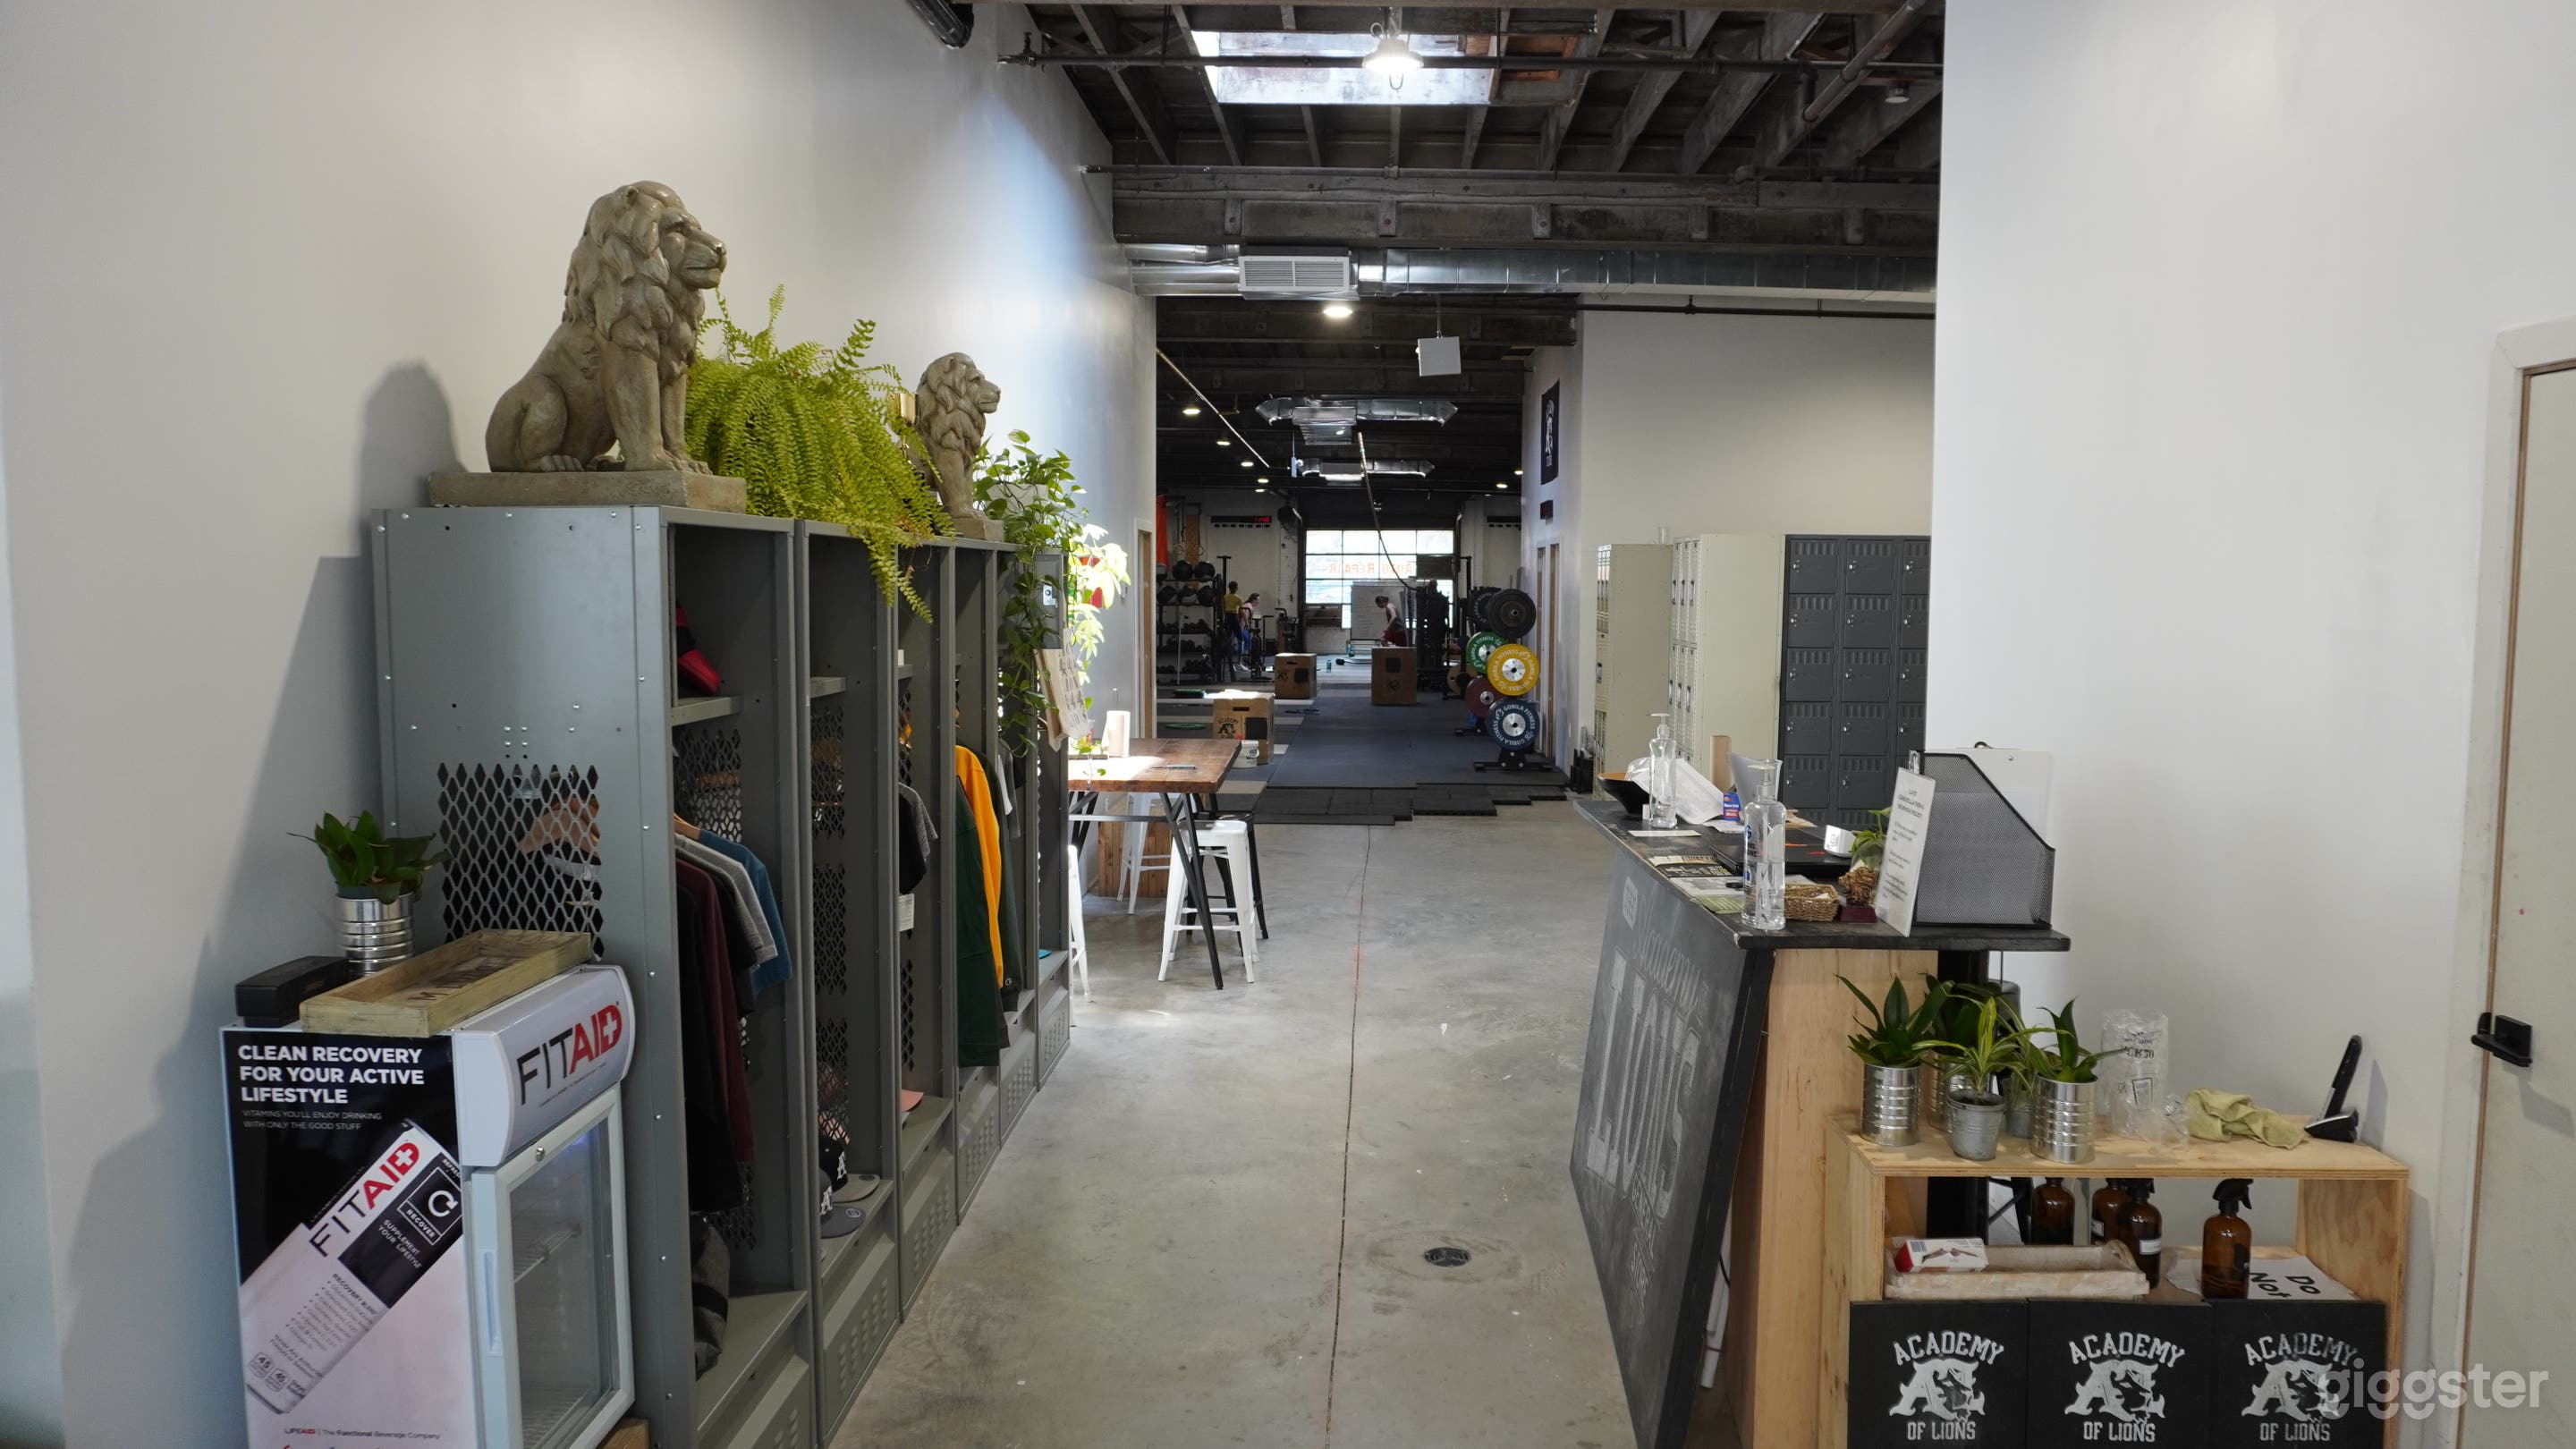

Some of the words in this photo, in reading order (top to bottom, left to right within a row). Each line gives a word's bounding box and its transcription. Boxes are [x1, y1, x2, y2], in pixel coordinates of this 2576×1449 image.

[238, 1045, 307, 1062] CLEAN
[313, 1046, 422, 1063] RECOVERY
[516, 1004, 623, 1106] FITAID
[240, 1066, 282, 1081] FOR
[286, 1067, 344, 1082] YOUR
[349, 1068, 425, 1085] ACTIVE
[1587, 948, 1701, 1218] LIONS
[242, 1087, 348, 1104] LIFESTYLE
[242, 1109, 281, 1118] VITAMINS
[313, 1111, 339, 1119] ENJOY
[342, 1112, 383, 1120] DRINKING
[267, 1121, 288, 1129] ONLY
[335, 1123, 361, 1131] STUFF
[309, 1142, 419, 1258] FITAID
[406, 1208, 436, 1240] RECOVER
[378, 1226, 396, 1243] YOUR
[383, 1219, 420, 1254] SUPPLEMENT
[1894, 1331, 2004, 1366] ACADEMY
[2069, 1332, 2185, 1368] ACADEMY
[2244, 1332, 2358, 1367] ACADEMY
[336, 1429, 372, 1437] Functional
[374, 1431, 405, 1439] Beverage
[408, 1432, 440, 1440] Company
[1907, 1421, 1926, 1440] OF
[1932, 1421, 1976, 1440] LIONS
[2083, 1421, 2103, 1440] OF
[2108, 1422, 2156, 1442] LIONS
[2259, 1423, 2279, 1441] OF
[2284, 1423, 2330, 1441] LIONS
